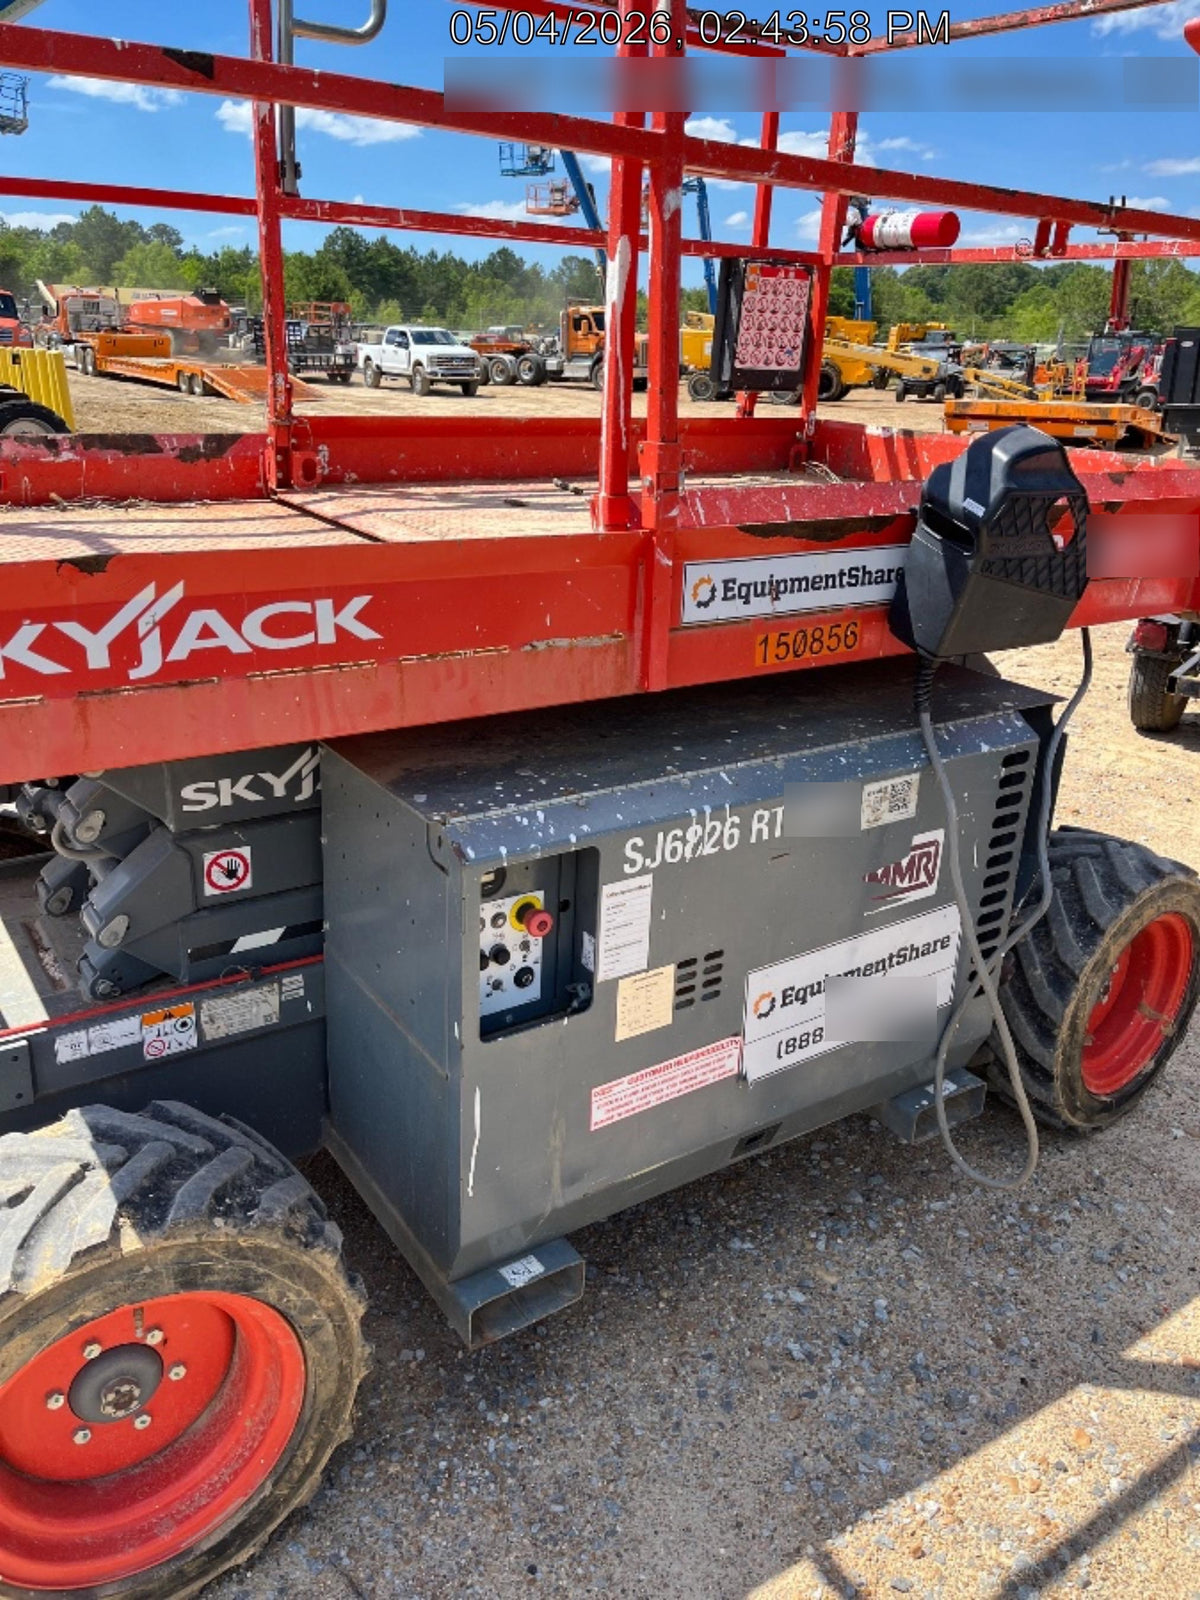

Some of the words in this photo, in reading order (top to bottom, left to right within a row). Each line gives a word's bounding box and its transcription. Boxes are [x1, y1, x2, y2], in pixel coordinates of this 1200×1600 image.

[721, 565, 906, 605] EquipmentShare
[758, 622, 858, 664] 150856
[180, 746, 322, 812] SKYJ
[780, 934, 950, 1007] EqumentShare
